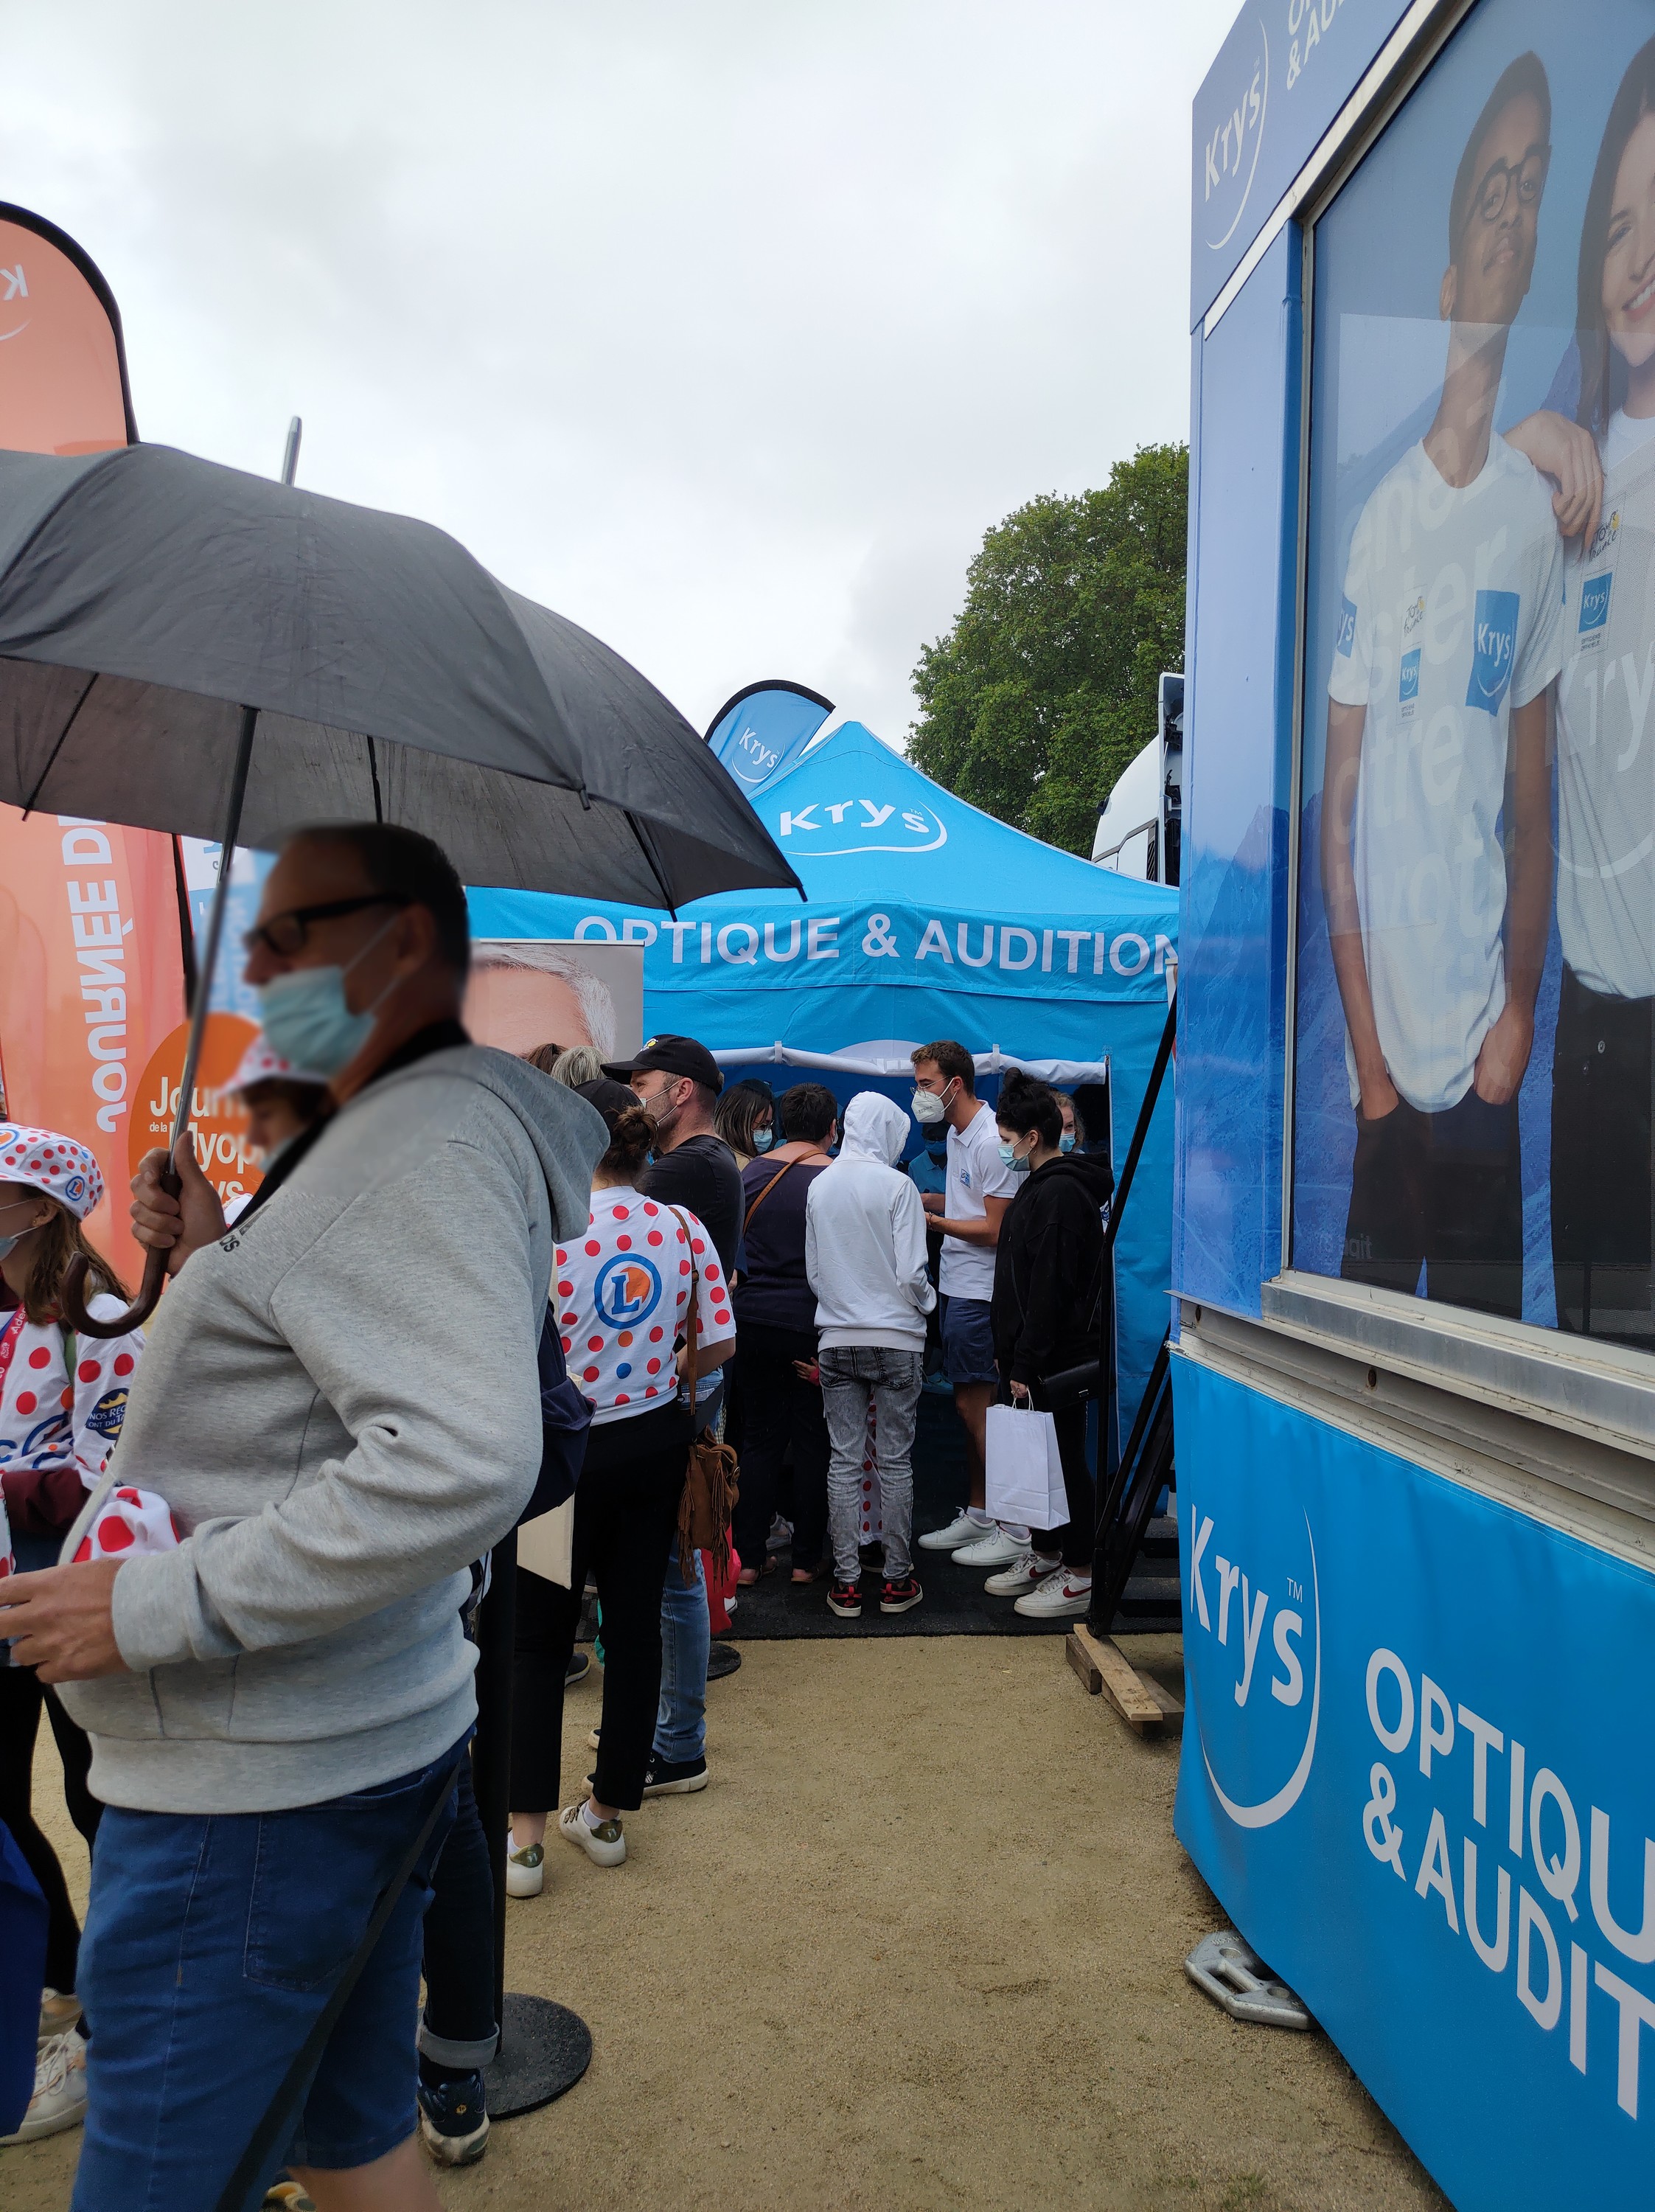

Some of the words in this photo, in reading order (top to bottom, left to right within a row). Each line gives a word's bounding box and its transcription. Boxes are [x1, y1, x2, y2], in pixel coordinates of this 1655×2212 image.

[1205, 72, 1260, 203] Krys
[1583, 591, 1606, 611] Krys
[1477, 623, 1511, 667] Krys
[739, 727, 778, 768] Krys
[780, 799, 930, 836] Krys
[861, 913, 900, 958] &
[89, 1412, 108, 1420] NOS
[1191, 1503, 1303, 1707] Krys
[1362, 1762, 1407, 1882] &
